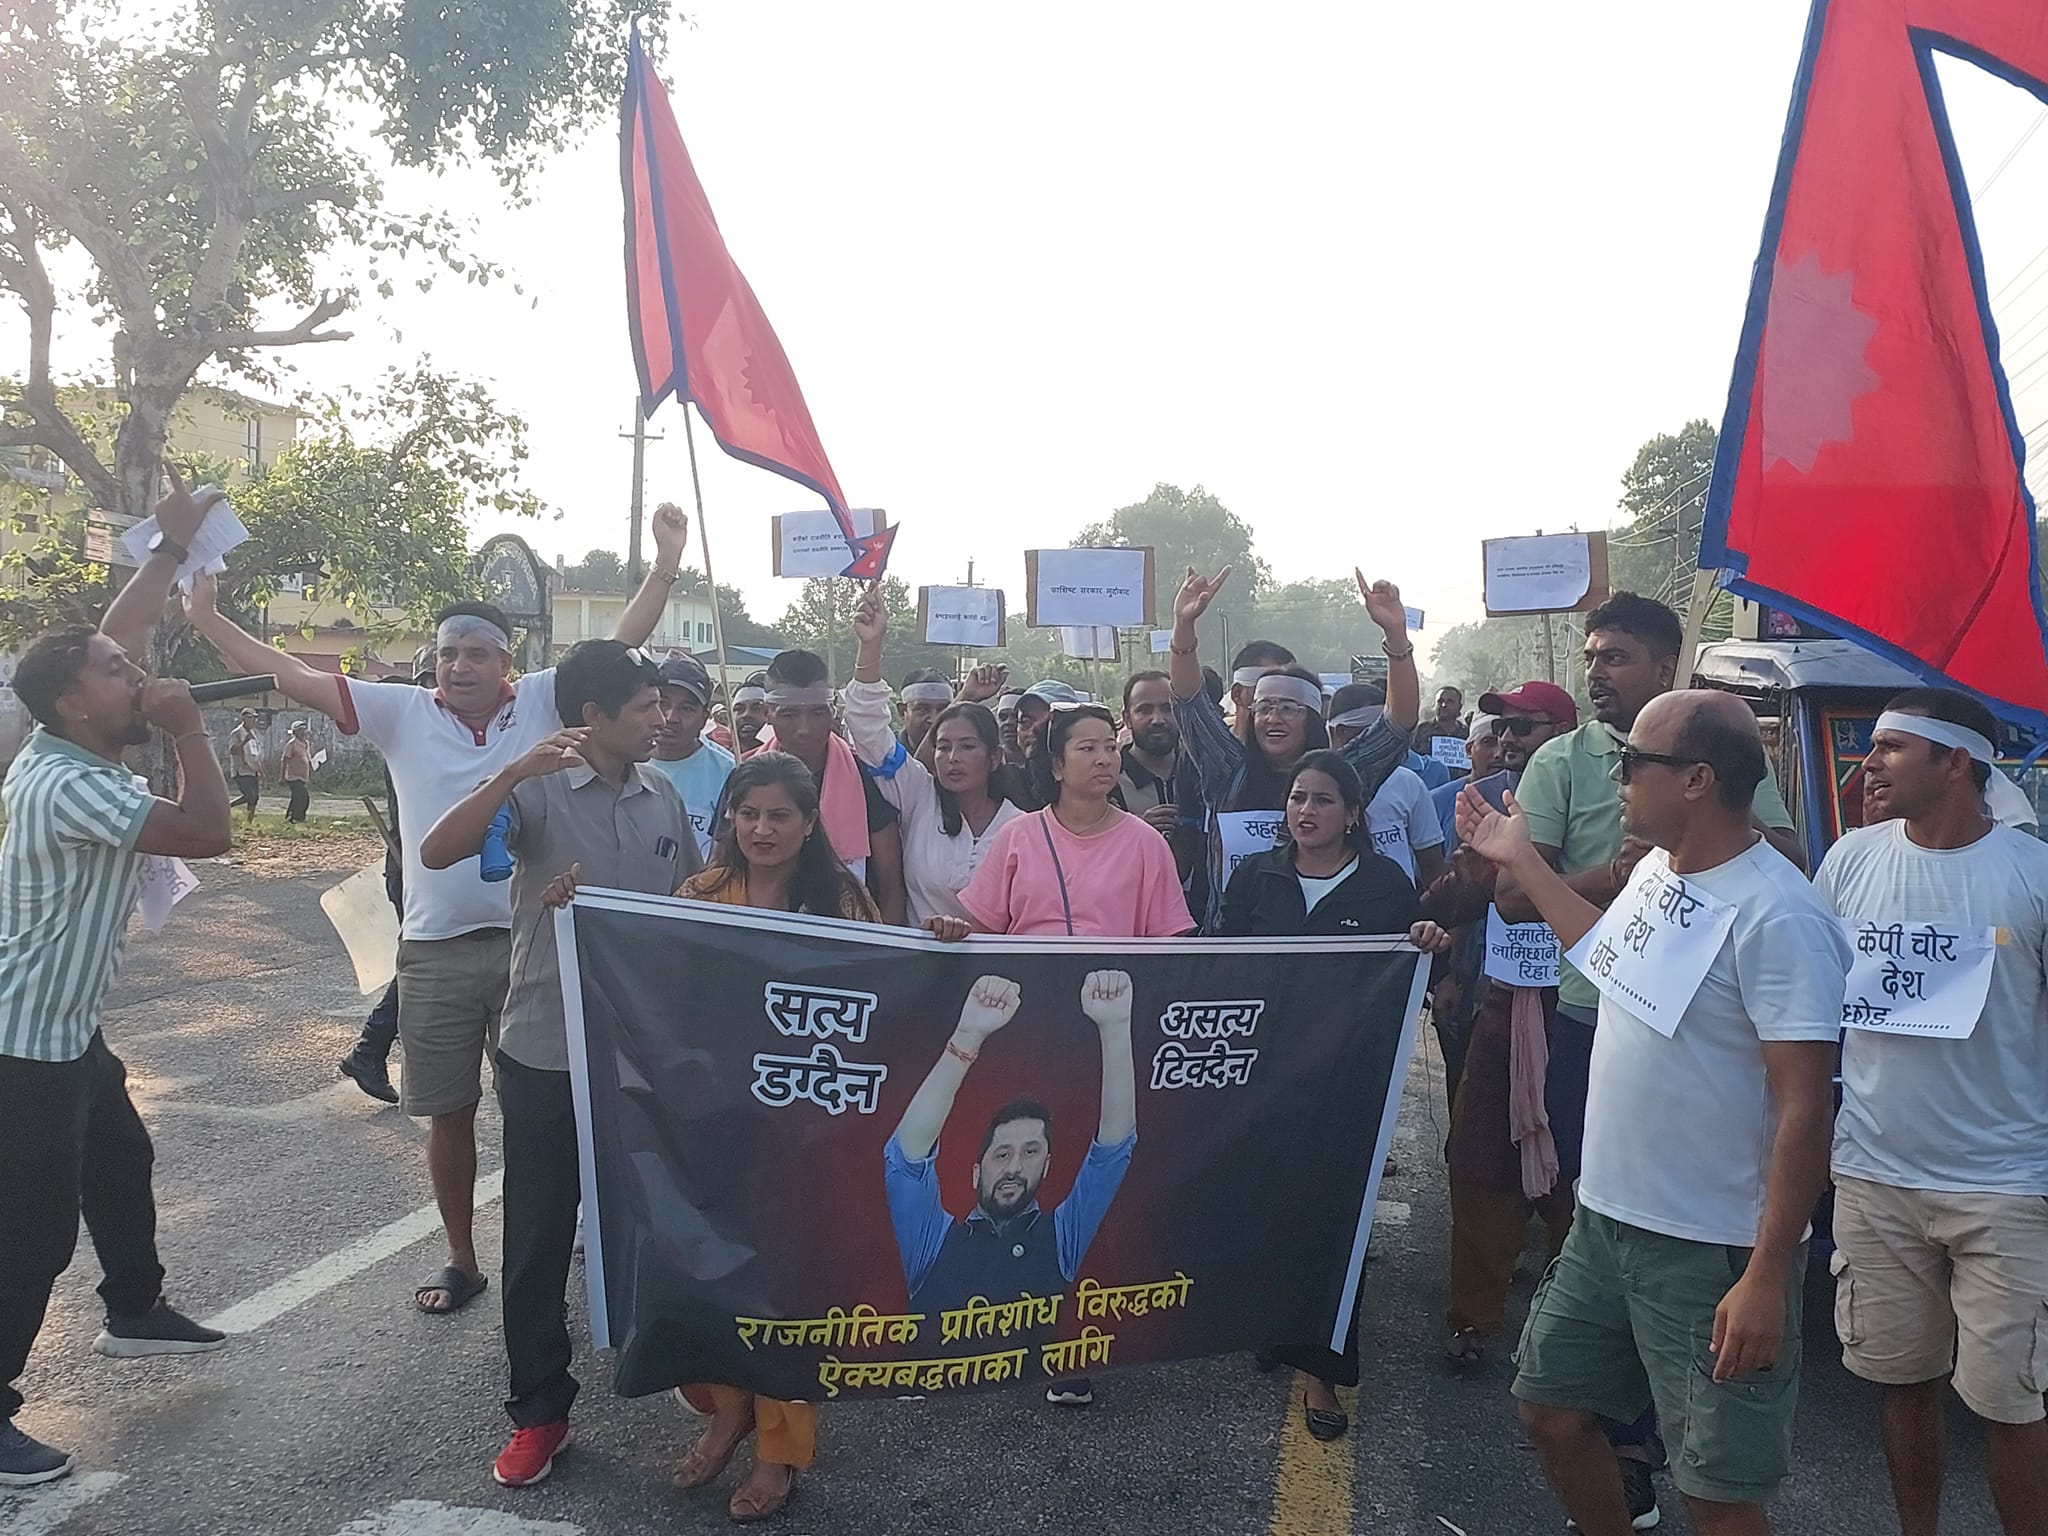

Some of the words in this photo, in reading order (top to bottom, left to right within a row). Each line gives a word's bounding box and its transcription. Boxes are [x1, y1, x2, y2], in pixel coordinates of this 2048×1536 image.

[1658, 880, 1705, 929] चोर
[1491, 942, 1559, 962] लामिछाने
[1623, 907, 1656, 959] देश
[1857, 921, 1906, 960] केपी
[1911, 925, 1960, 963] चोर
[1518, 960, 1551, 981] रिहा
[1881, 961, 1927, 1001] देश
[766, 982, 877, 1042] सत्य
[1161, 1000, 1264, 1038] असत्य
[751, 1044, 887, 1115] डग्दैन
[1150, 1040, 1258, 1089] टिक्दैन
[735, 1303, 926, 1351] राजनीतिक
[940, 1291, 1063, 1345] प्रतिशोध
[1076, 1271, 1195, 1322] विरुद्धको
[818, 1347, 1029, 1398] ऐक्यबद्धताका
[1041, 1325, 1115, 1377] लागि
